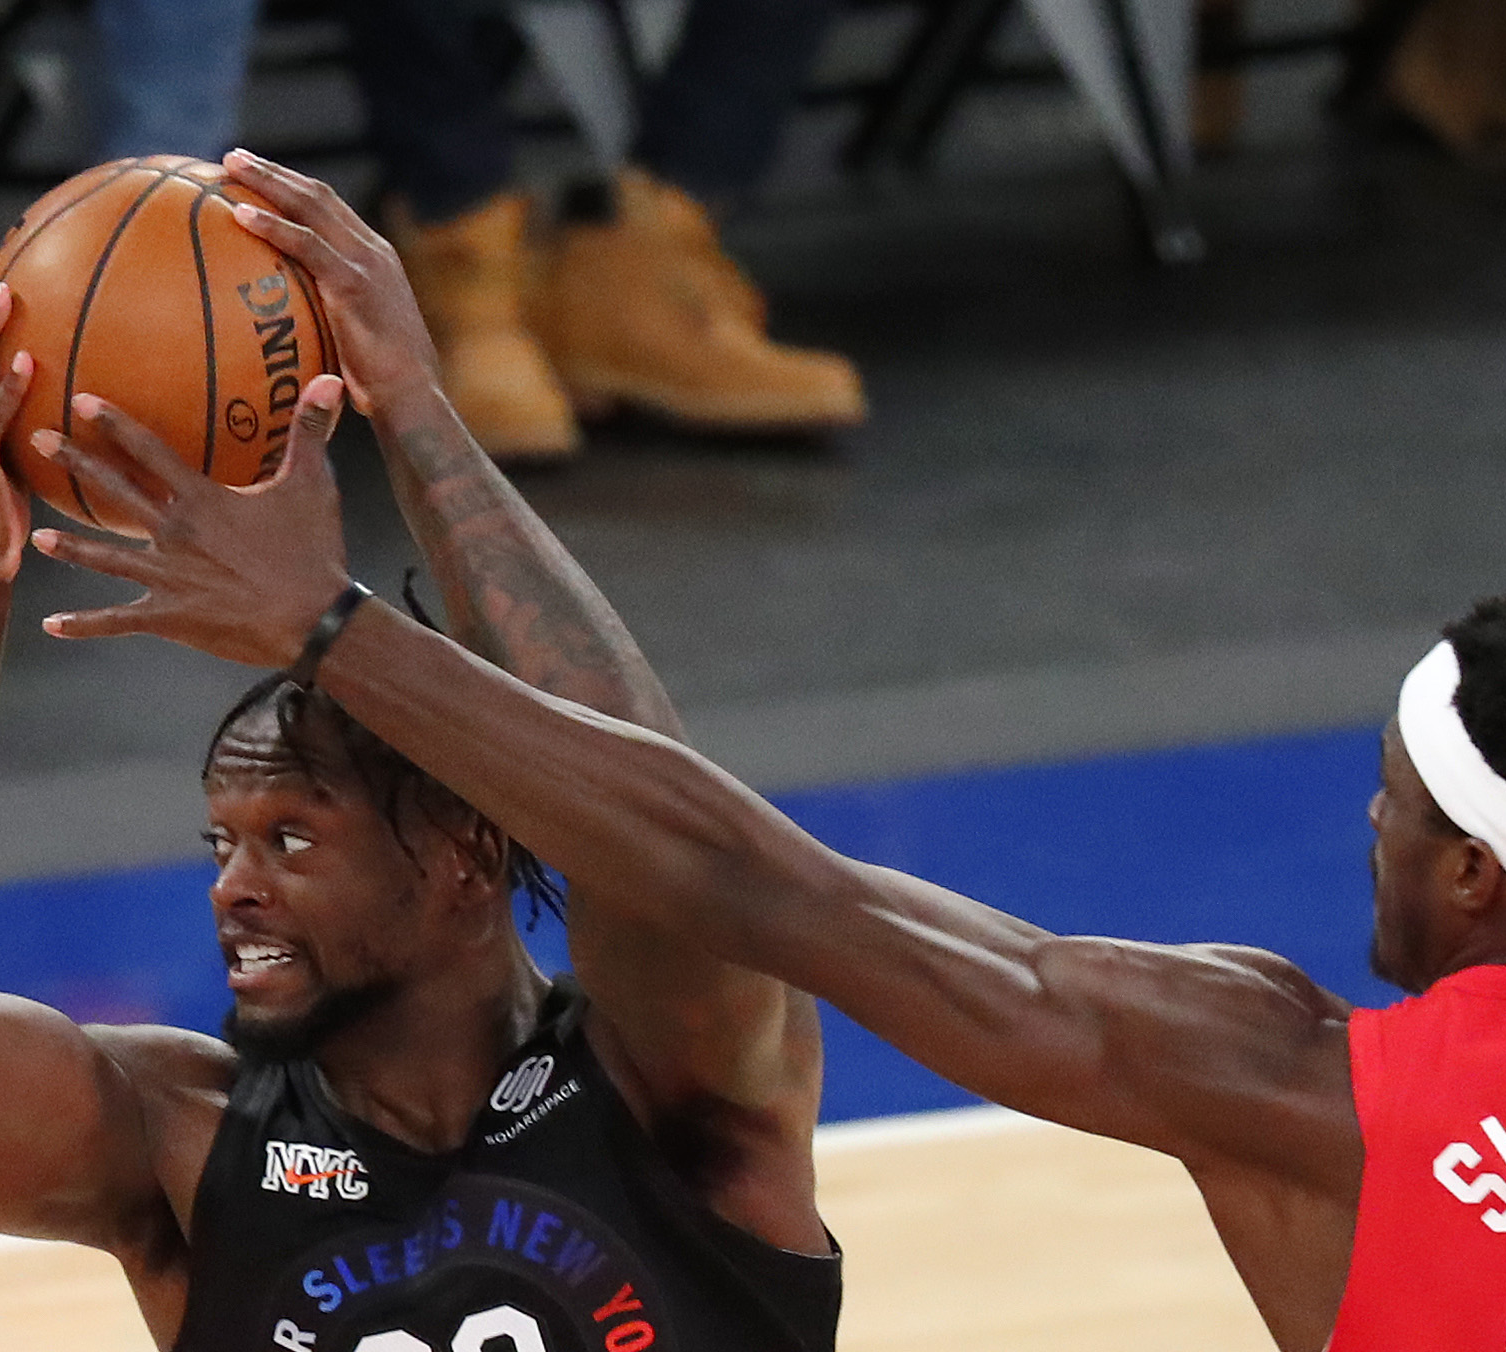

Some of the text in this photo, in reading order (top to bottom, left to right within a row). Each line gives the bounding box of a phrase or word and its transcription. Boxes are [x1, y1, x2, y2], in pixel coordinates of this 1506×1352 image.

[238, 274, 300, 484] ALDING
[261, 1140, 370, 1200] NYC
[302, 1199, 463, 1313] SLEES
[488, 1198, 608, 1287] NEW
